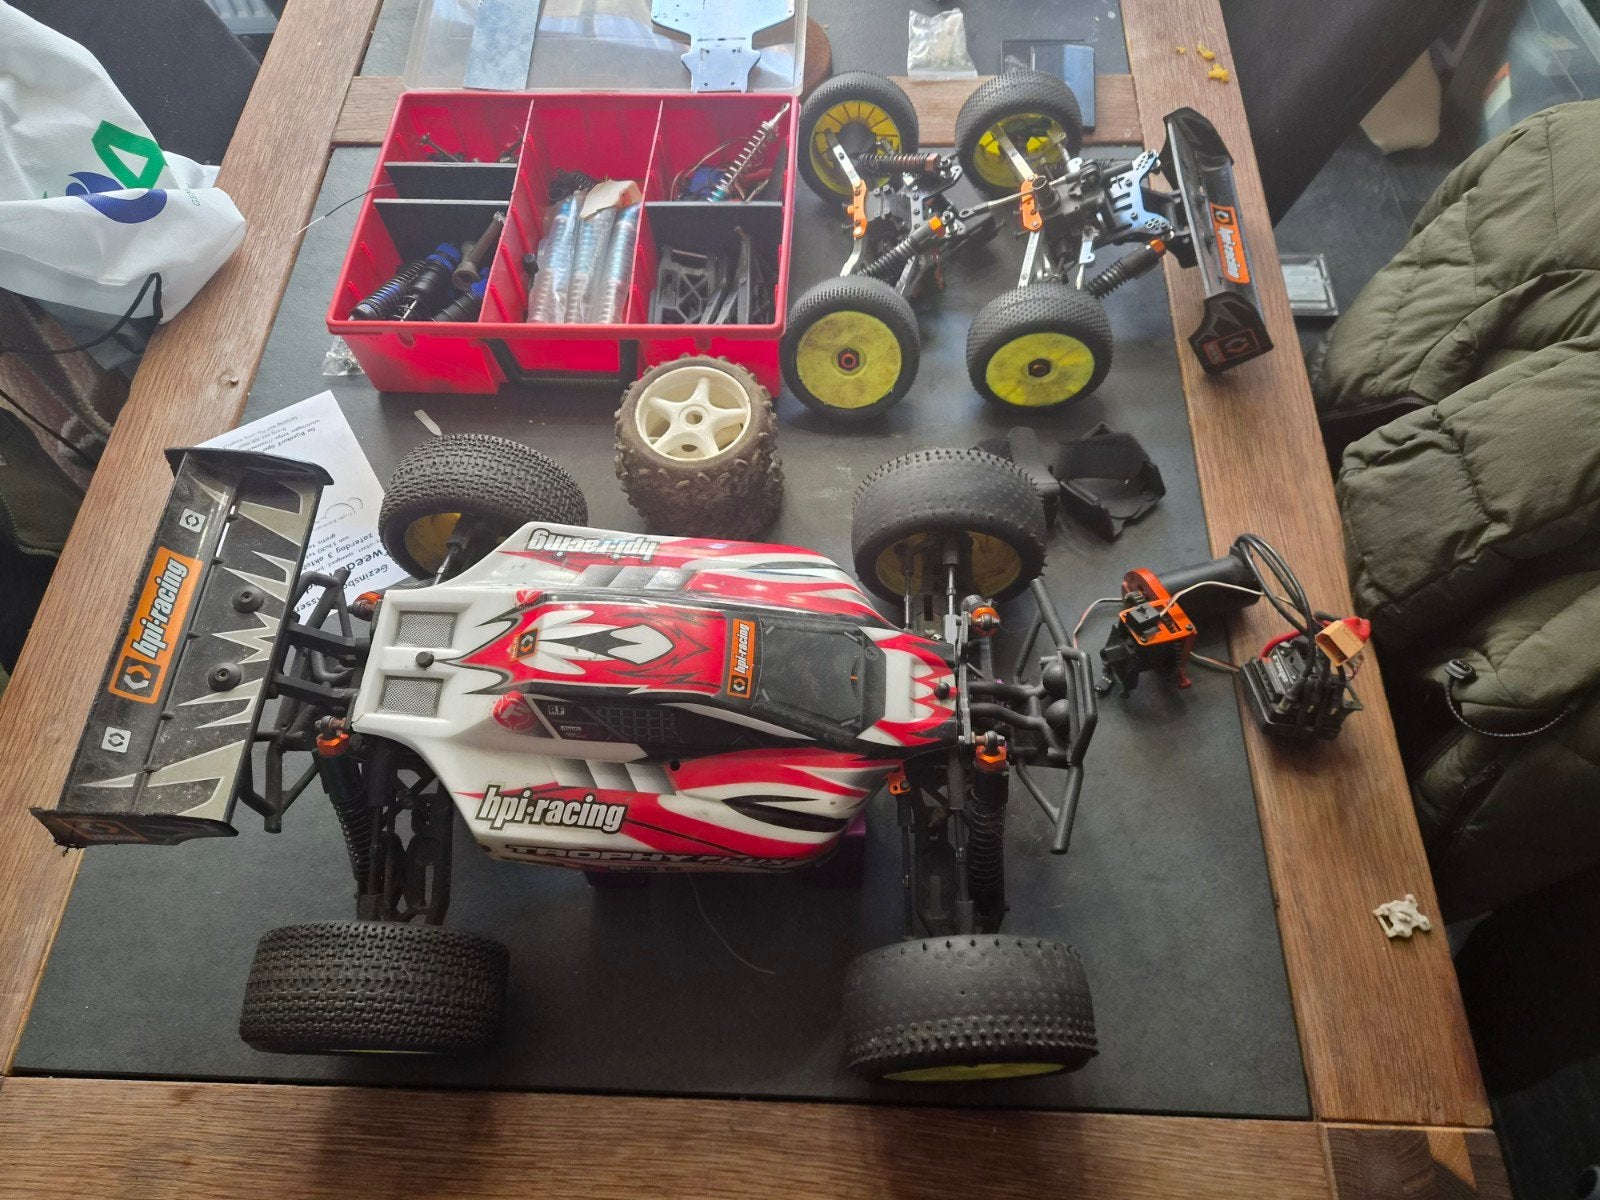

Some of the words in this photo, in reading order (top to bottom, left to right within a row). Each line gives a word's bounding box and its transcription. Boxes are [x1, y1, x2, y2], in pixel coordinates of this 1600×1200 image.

[336, 533, 373, 555] zaterdag
[343, 564, 388, 589] Gezinsbo
[505, 844, 696, 862] TROPHY
